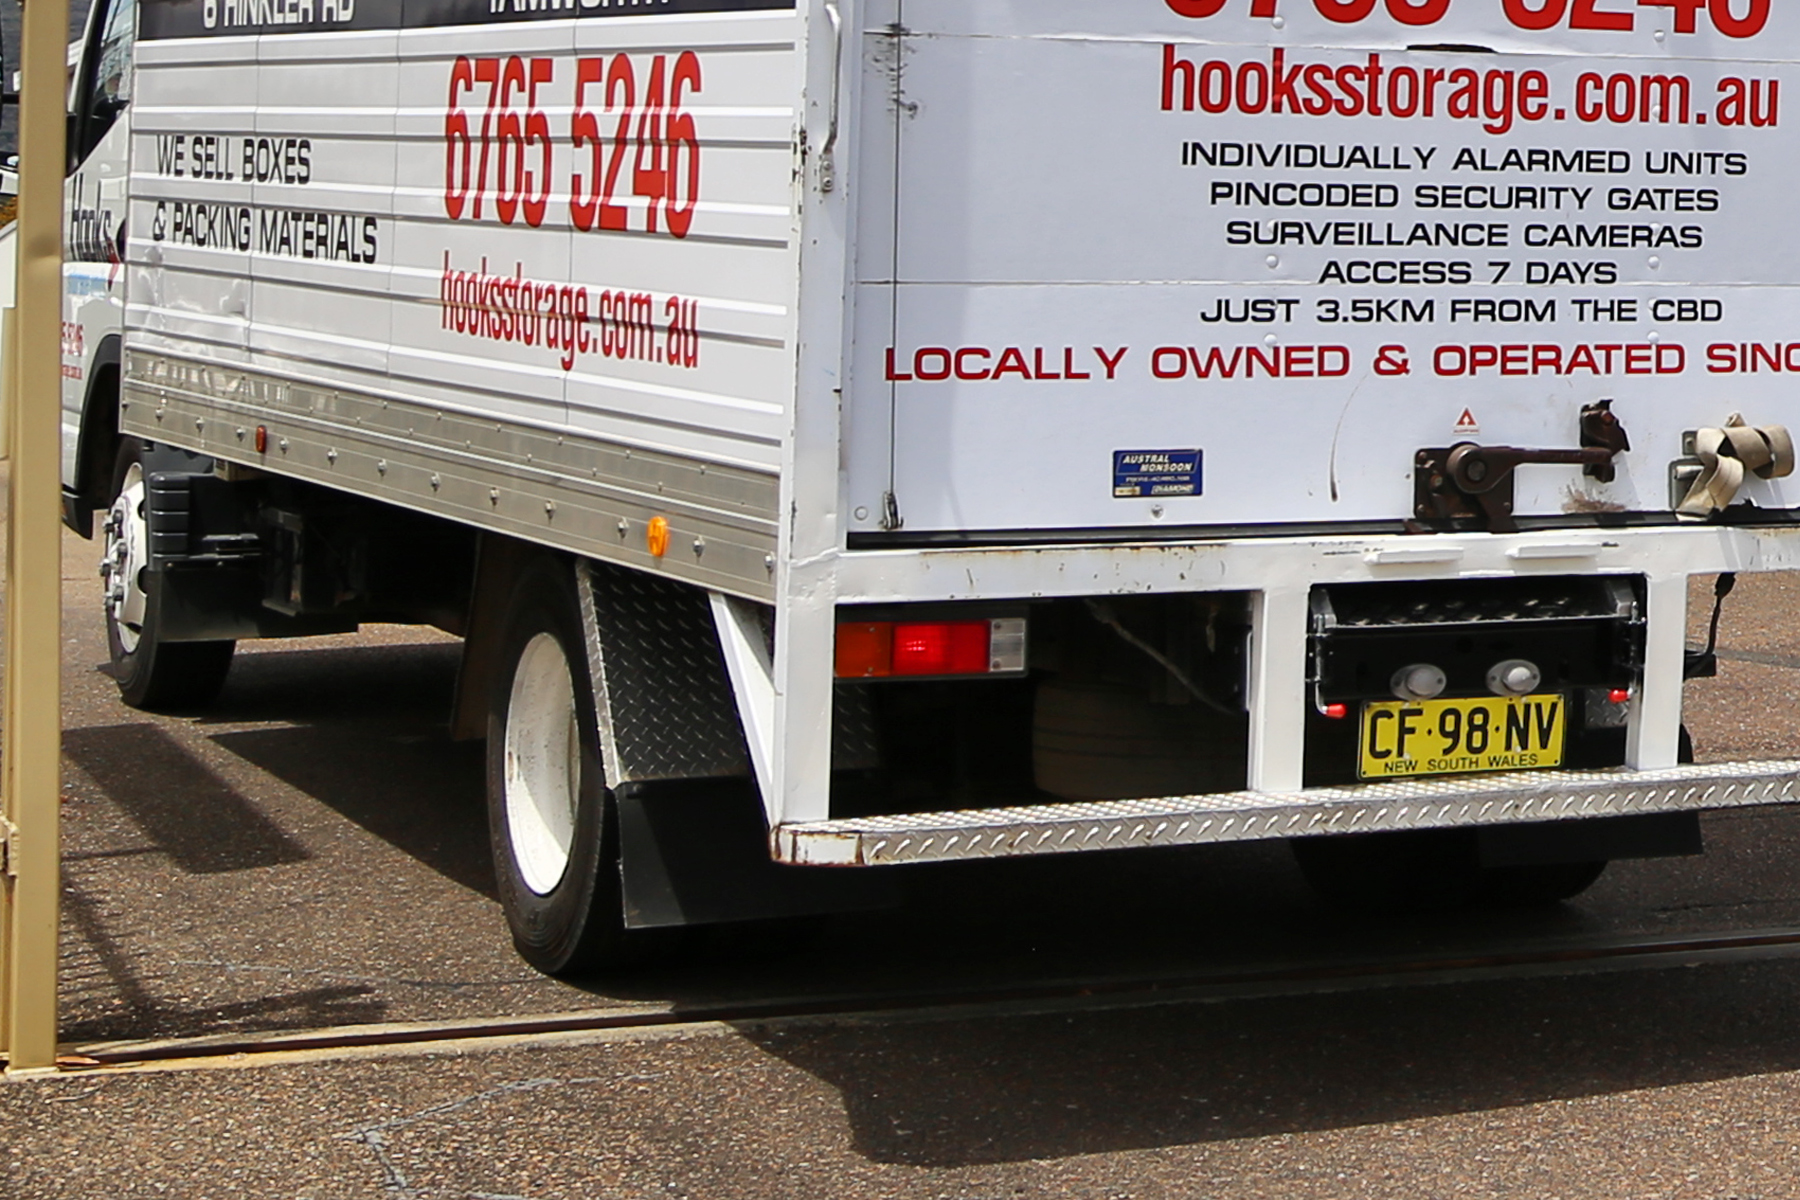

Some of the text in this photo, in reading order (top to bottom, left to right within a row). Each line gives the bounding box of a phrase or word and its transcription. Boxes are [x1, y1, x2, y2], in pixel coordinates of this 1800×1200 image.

[1160, 43, 1779, 135] hooksstorage.com.au
[157, 134, 312, 184] WE SELL BOXES
[445, 50, 701, 239] 6765 5246
[1181, 142, 1747, 175] INDIVIDUALLY ALARMED UNITS
[1211, 182, 1719, 212] PINCODED SECURITY GATES
[153, 200, 377, 264] & PACKING MATERIALS
[1226, 221, 1703, 249] SURVEILLANCE CAMERAS
[1319, 261, 1618, 285] ACCESS 7 DAYS
[441, 249, 699, 371] hooksstorage.com.au
[1200, 299, 1723, 323] JUST 3.5KM FROM THE CBD
[885, 346, 1129, 381] LOCALLY
[1152, 345, 1350, 378] OWNED
[1373, 345, 1410, 377] &
[1433, 343, 1685, 377] OPERATED
[1123, 454, 1169, 464] AUSTRAL
[1140, 462, 1193, 472] MONSOON
[1384, 753, 1538, 773] NEW SOUTH WALES
